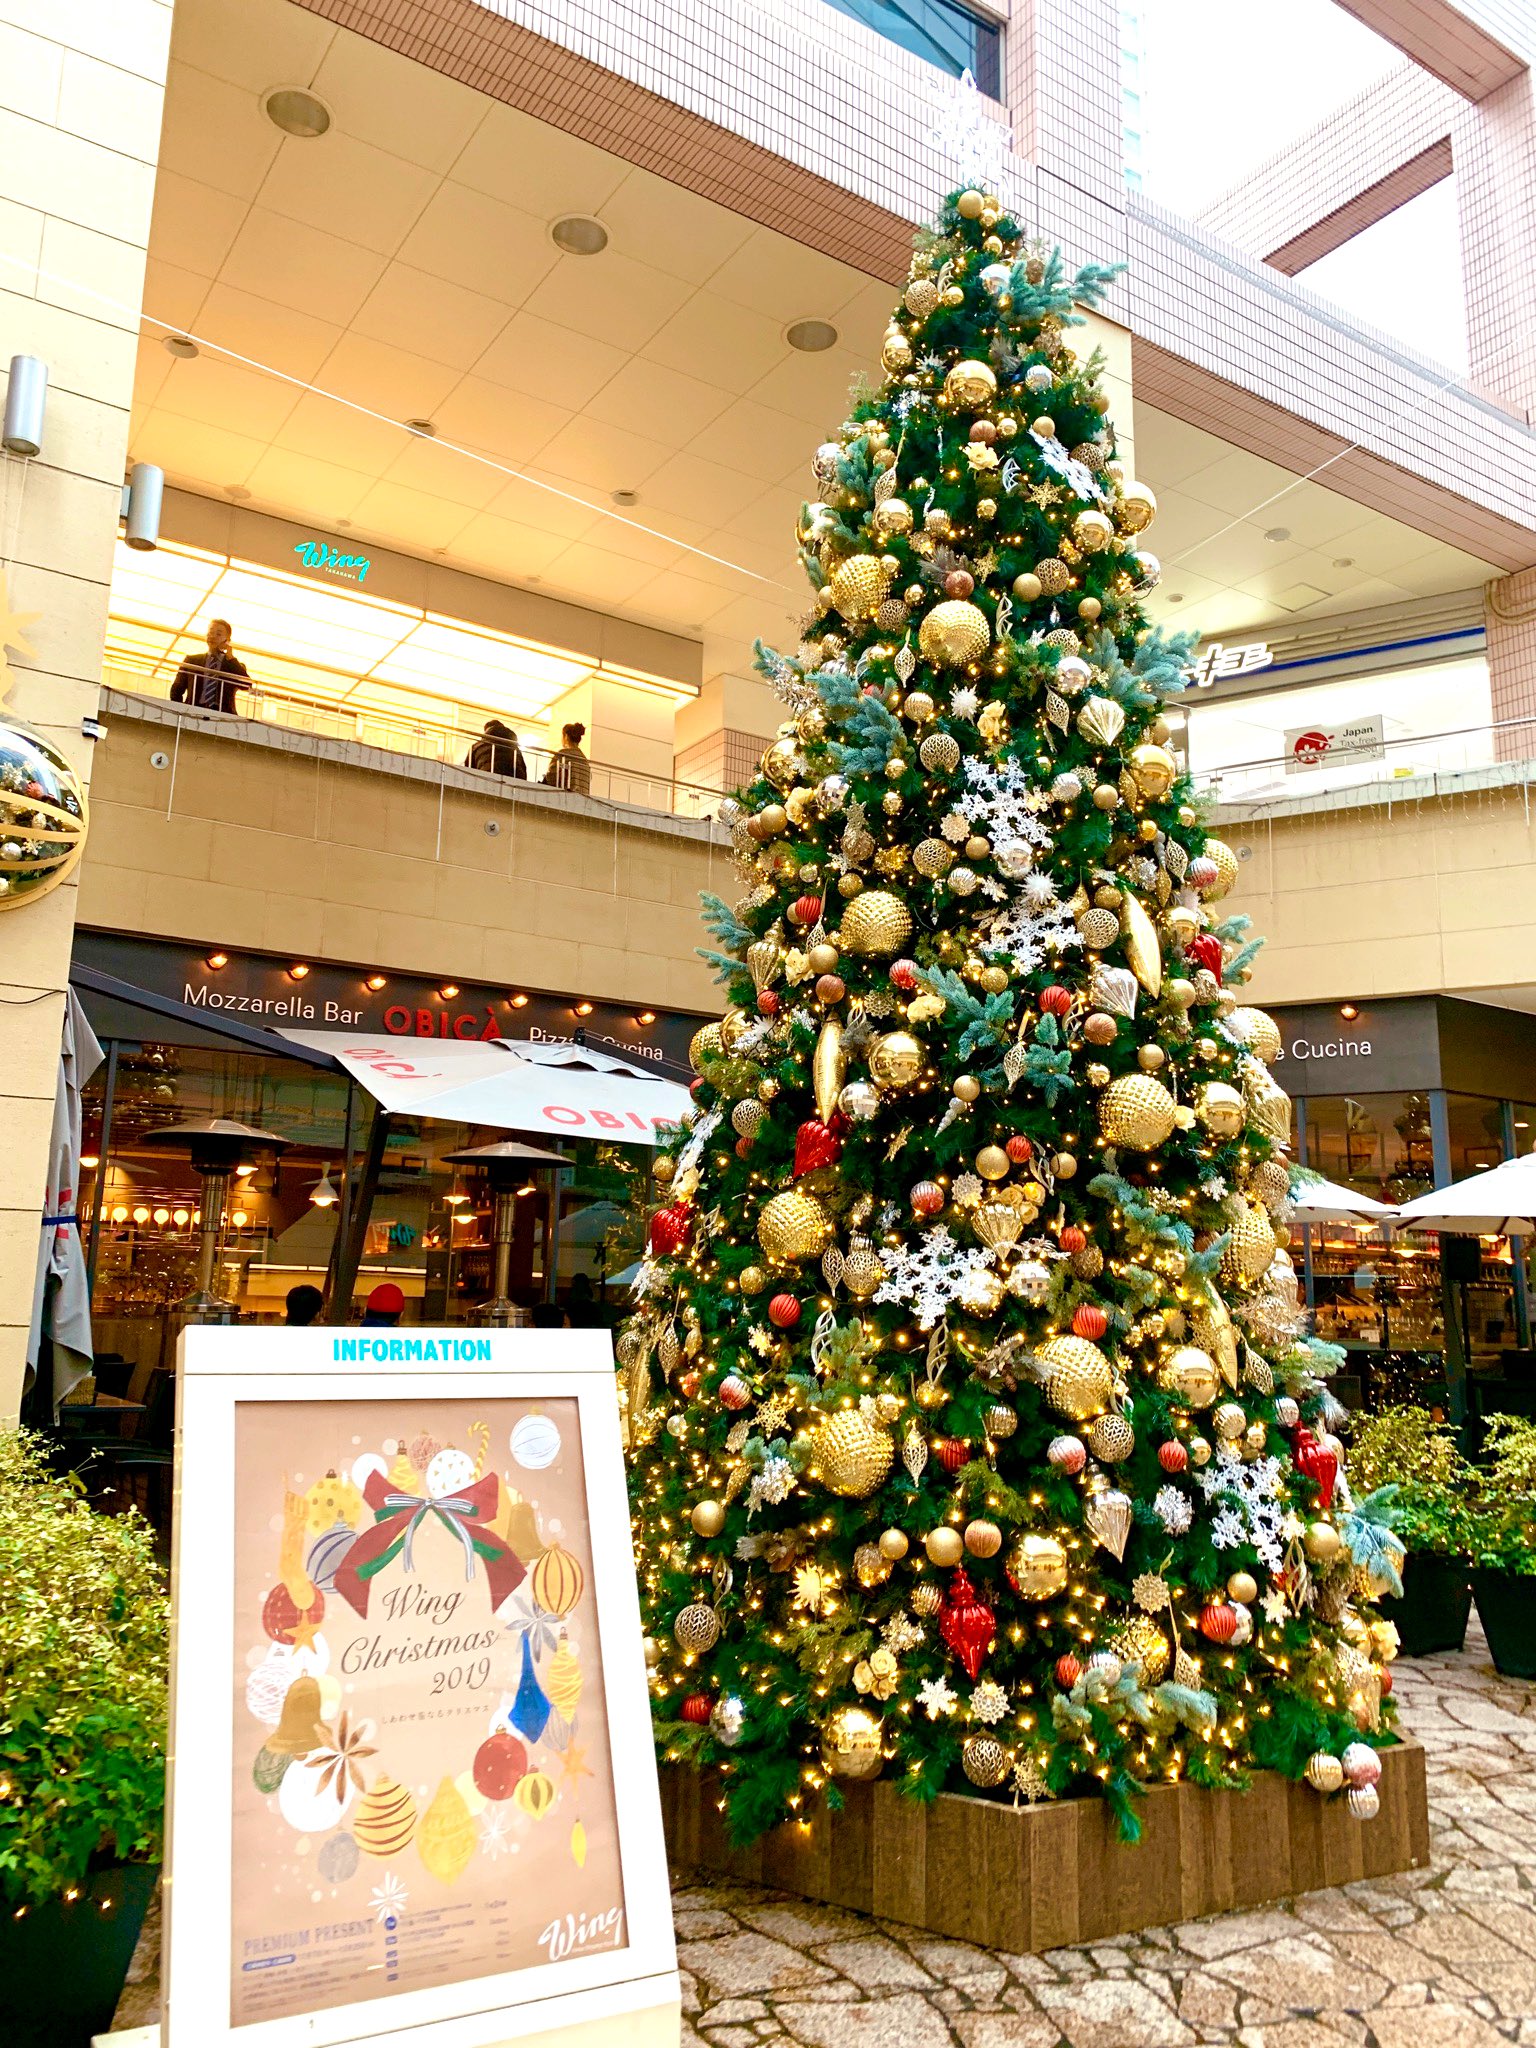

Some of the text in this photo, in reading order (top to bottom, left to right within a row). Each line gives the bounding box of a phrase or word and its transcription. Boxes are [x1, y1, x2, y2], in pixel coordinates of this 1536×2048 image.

[294, 541, 371, 583] Wing
[1342, 726, 1374, 738] Japan
[183, 983, 364, 1025] Mozzarella Bar
[383, 1005, 503, 1042] OBICÀ
[1291, 1038, 1372, 1060] Cucina
[333, 1338, 492, 1362] INFORMATION
[382, 1583, 466, 1626] Wing
[341, 1629, 500, 1675] Christmas
[429, 1657, 491, 1697] 2019
[314, 1918, 375, 1944] PRESENT
[537, 1906, 624, 1962] Wing
